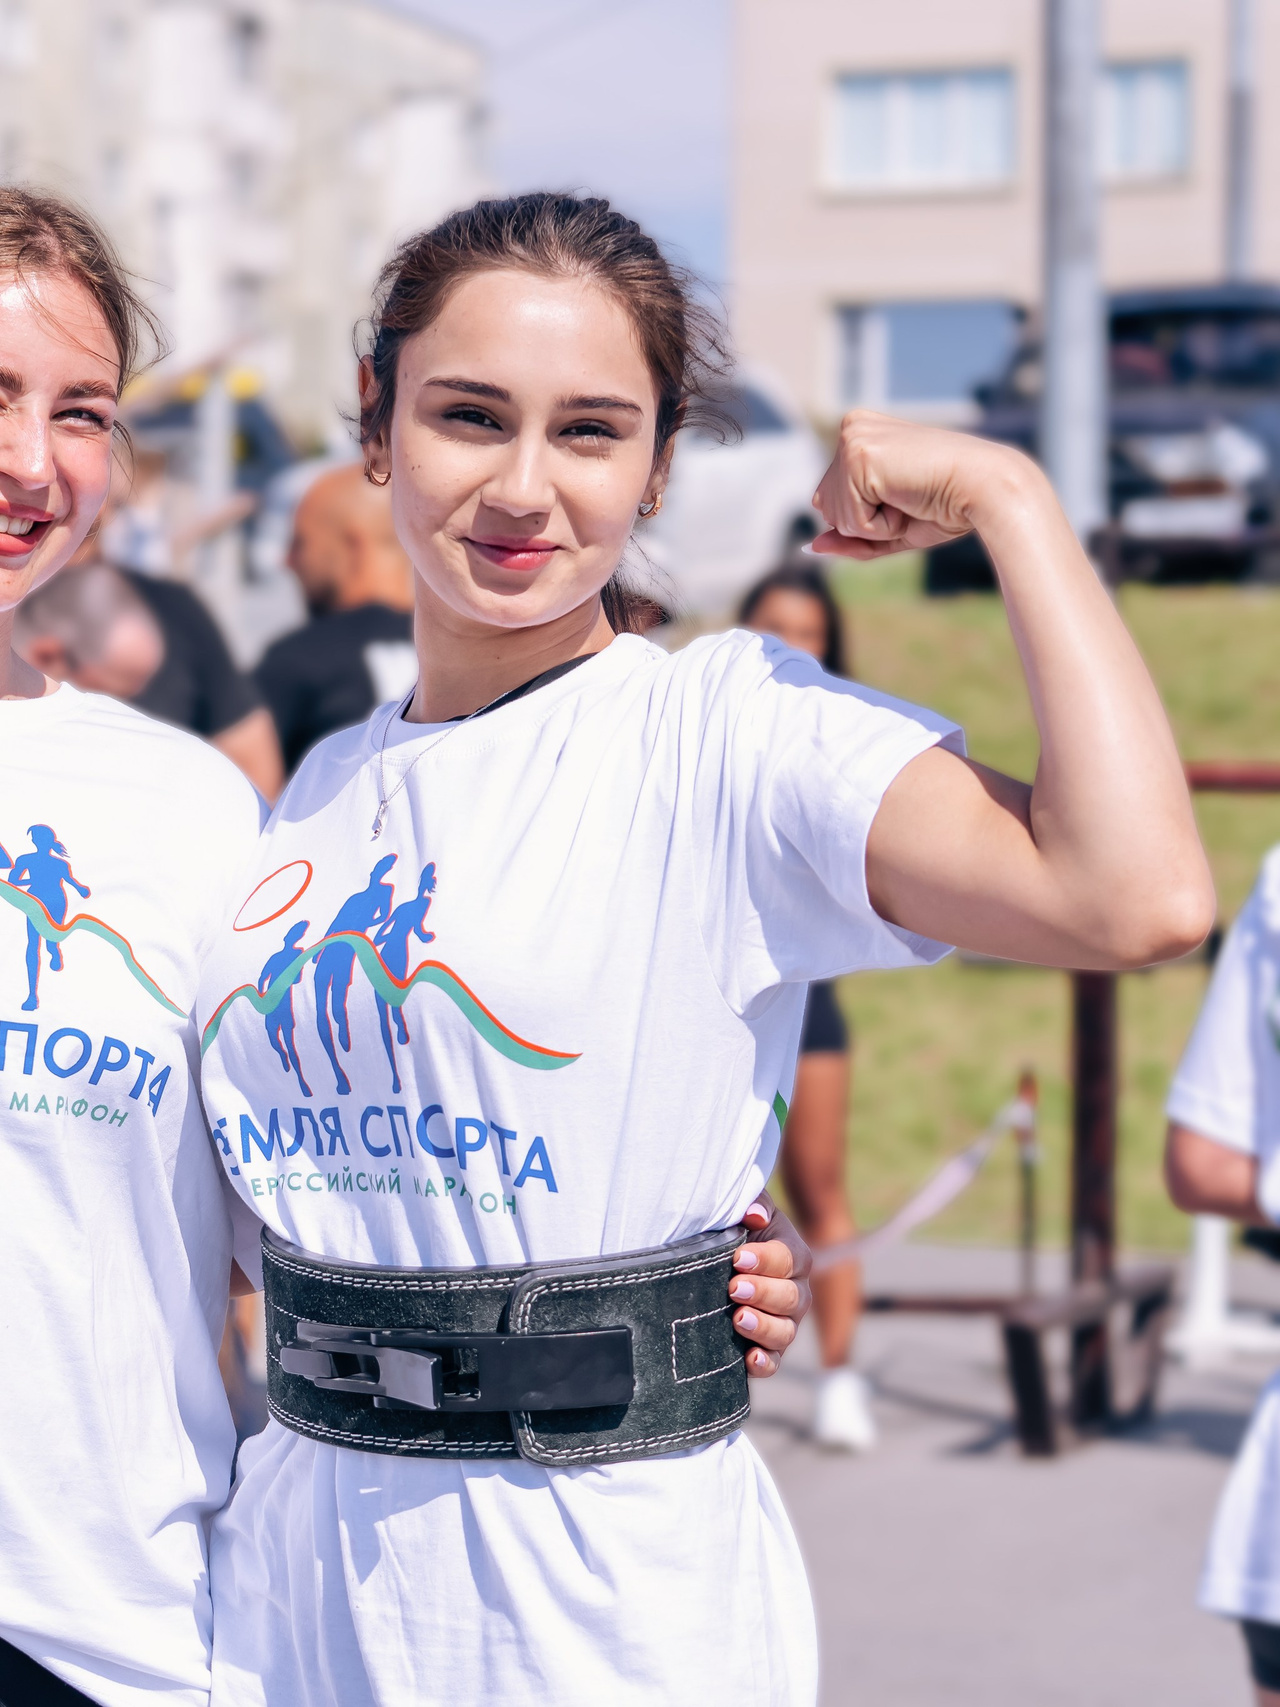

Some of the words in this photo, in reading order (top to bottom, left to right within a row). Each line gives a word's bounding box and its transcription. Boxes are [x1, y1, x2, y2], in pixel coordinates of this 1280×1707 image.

[213, 1106, 351, 1176] МЛЯ
[360, 1104, 559, 1193] СПОРТА
[413, 1175, 517, 1215] АРАОН
